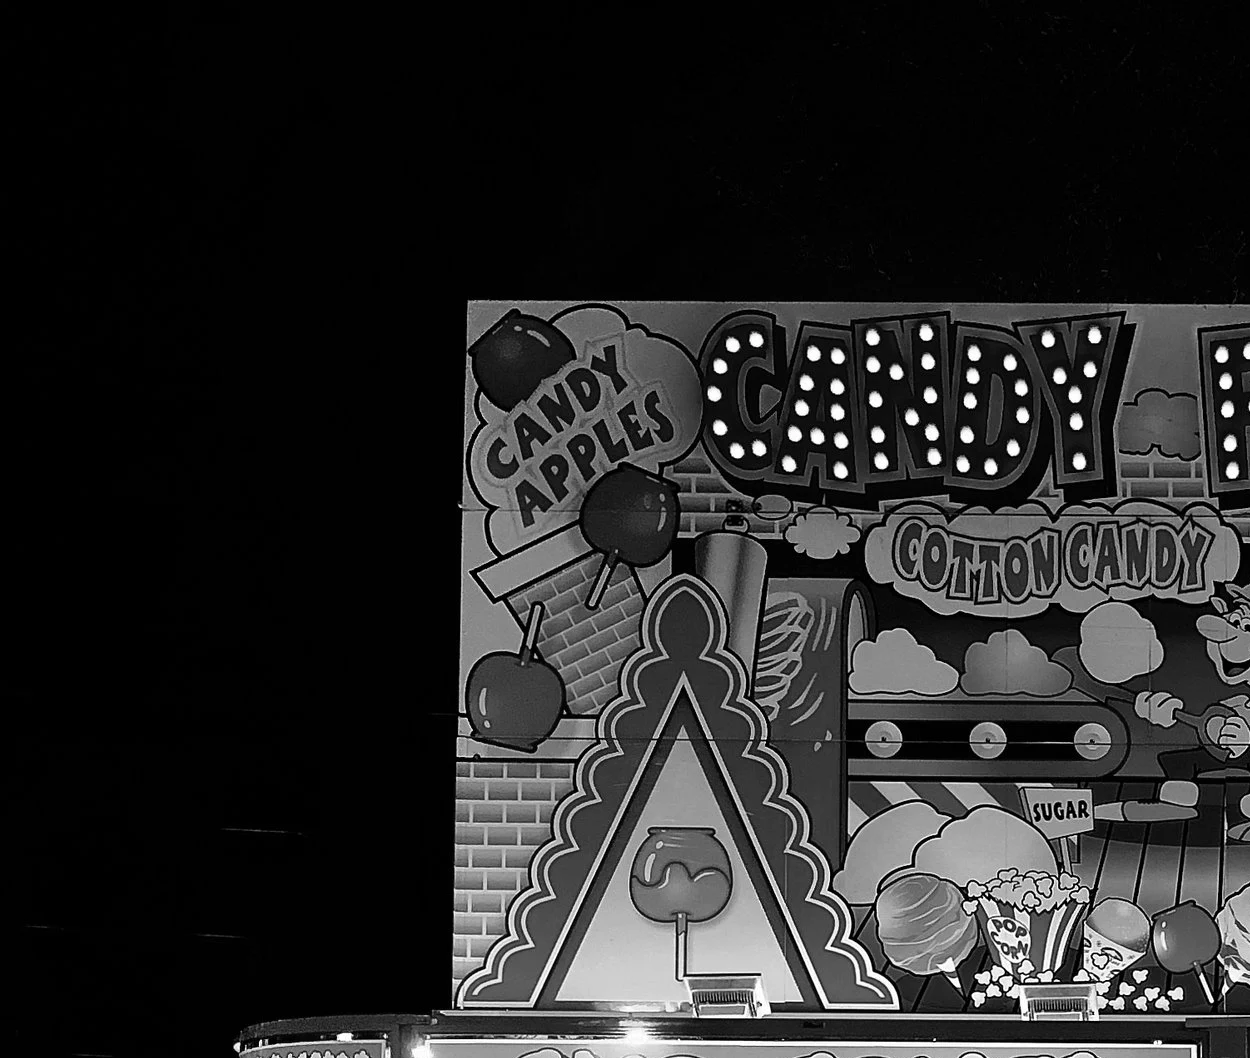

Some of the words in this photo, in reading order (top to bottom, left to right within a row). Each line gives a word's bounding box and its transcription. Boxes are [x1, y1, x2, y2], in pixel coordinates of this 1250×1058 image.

[487, 345, 628, 479] CANDY
[700, 311, 1130, 495] CANDY
[515, 390, 675, 528] APPLES
[893, 517, 1061, 603] COTTON
[1064, 517, 1214, 593] CANDY
[1033, 800, 1090, 822] SUGAR
[991, 931, 1029, 960] CORN
[992, 919, 1027, 938] POP
